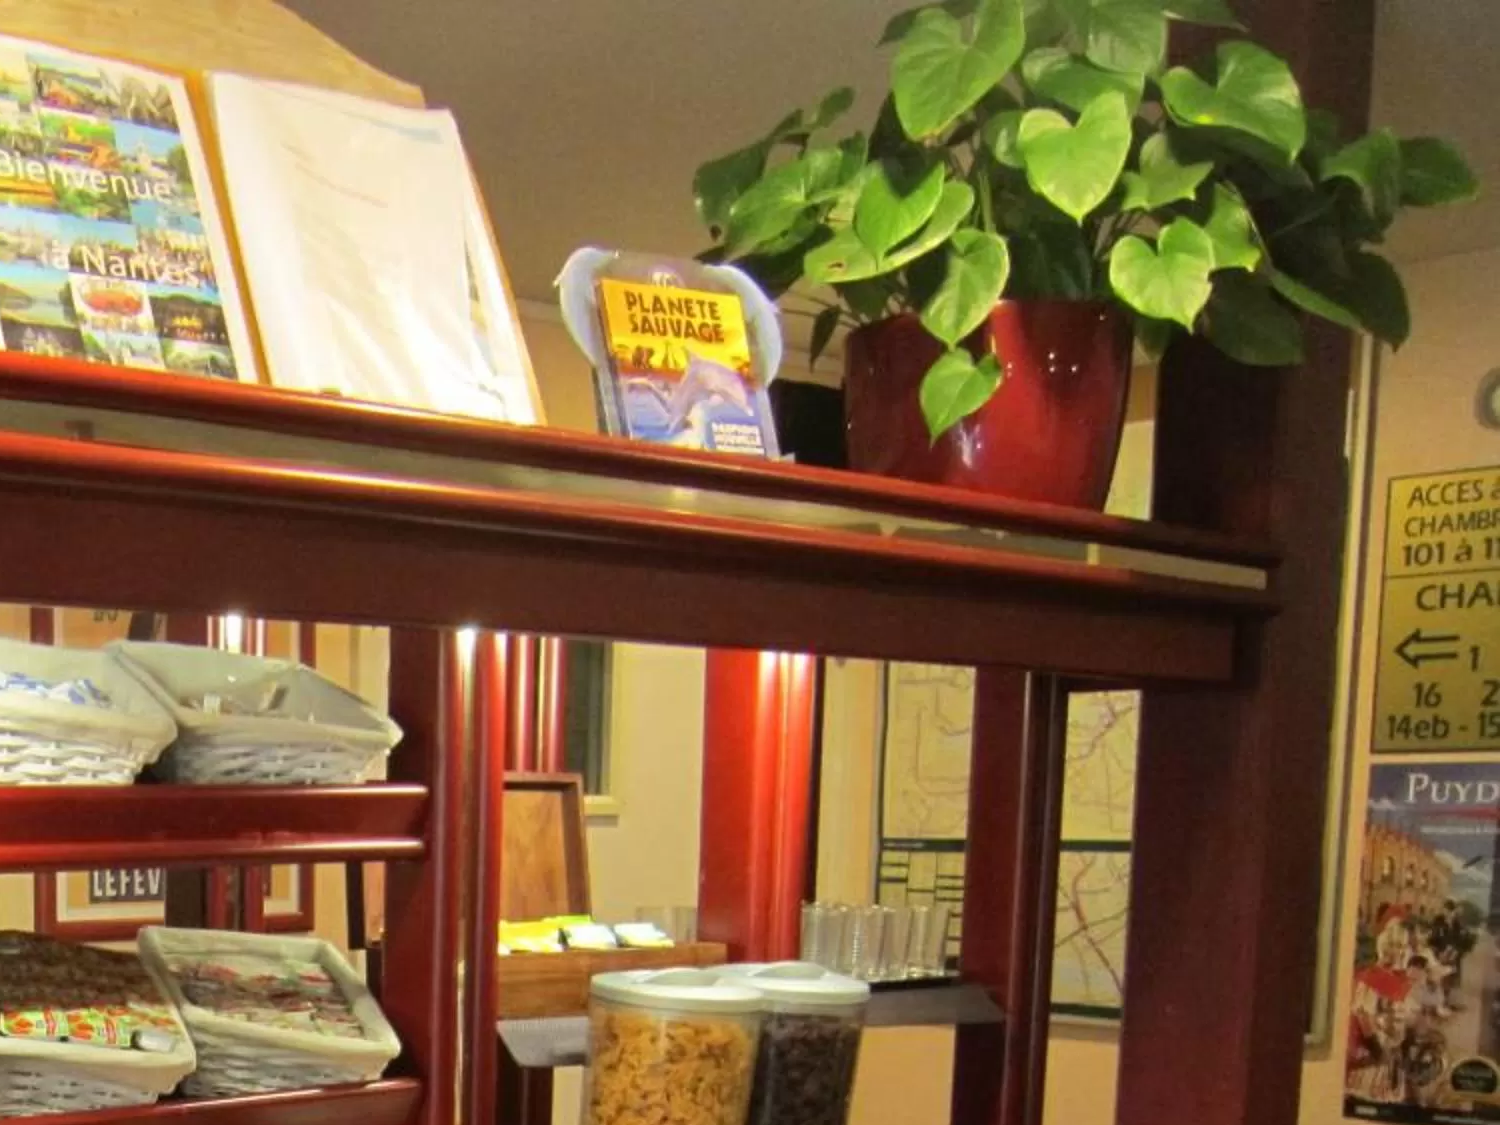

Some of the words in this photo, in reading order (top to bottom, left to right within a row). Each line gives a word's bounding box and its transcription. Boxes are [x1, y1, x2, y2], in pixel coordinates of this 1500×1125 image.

[80, 244, 200, 287] Nantes
[624, 289, 721, 321] PLANETE
[629, 313, 725, 343] SAUVAGE
[1406, 479, 1484, 509] ACCES
[1402, 541, 1445, 567] 101
[1453, 537, 1473, 564] à
[1416, 580, 1500, 612] CHA
[1413, 681, 1442, 708] 16
[93, 868, 166, 897] LEFEV
